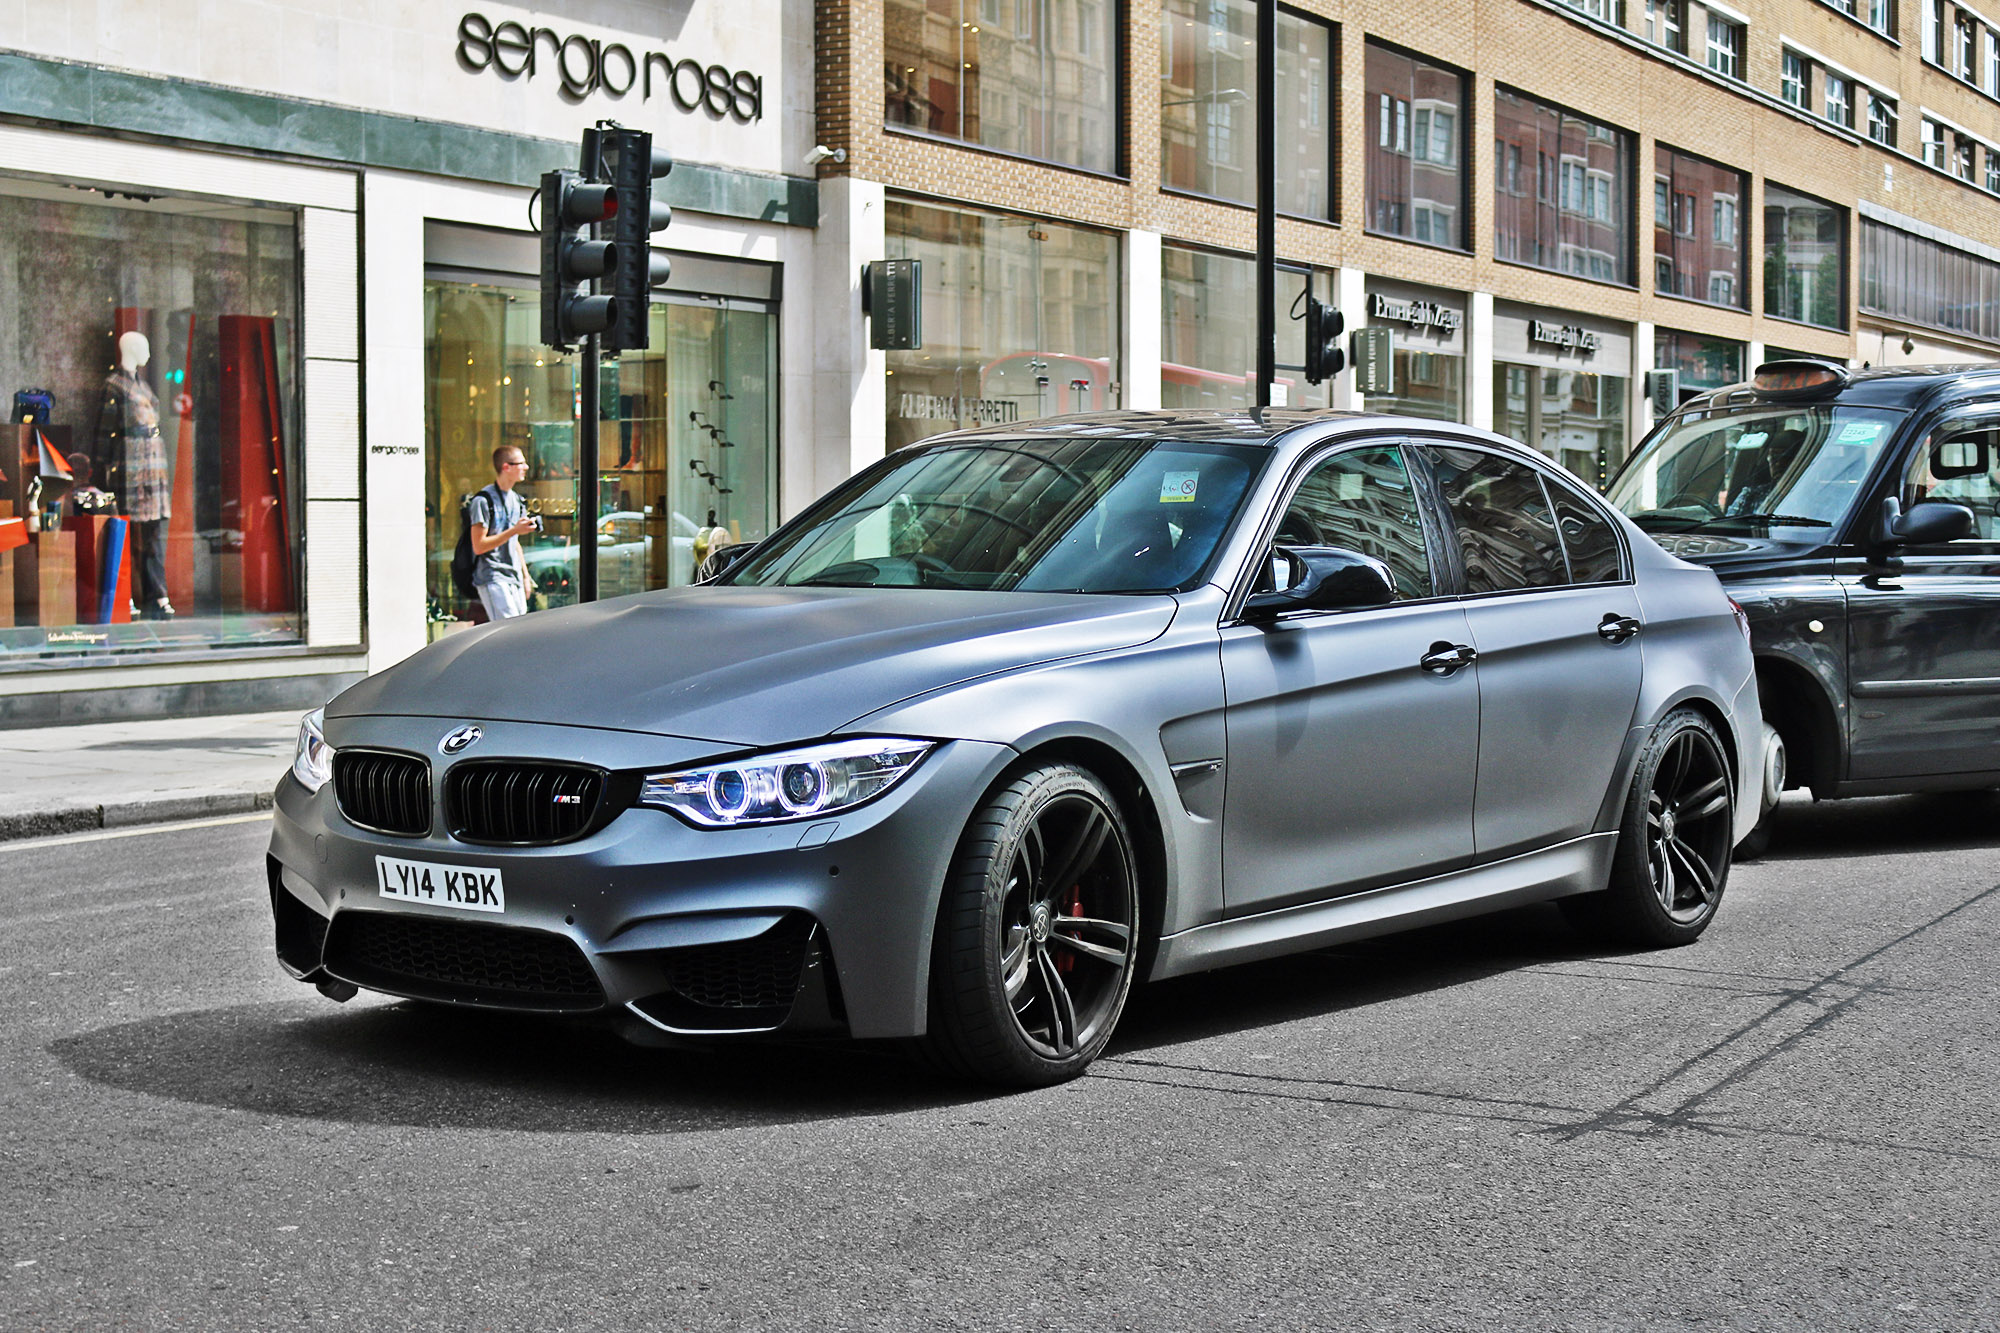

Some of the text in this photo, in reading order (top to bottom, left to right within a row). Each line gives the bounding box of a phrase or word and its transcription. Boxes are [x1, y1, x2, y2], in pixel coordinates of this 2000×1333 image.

[456, 13, 763, 124] sergio rossi
[899, 394, 958, 419] ALBERTA
[560, 795, 581, 804] M3
[381, 862, 499, 906] LY14 KBK
